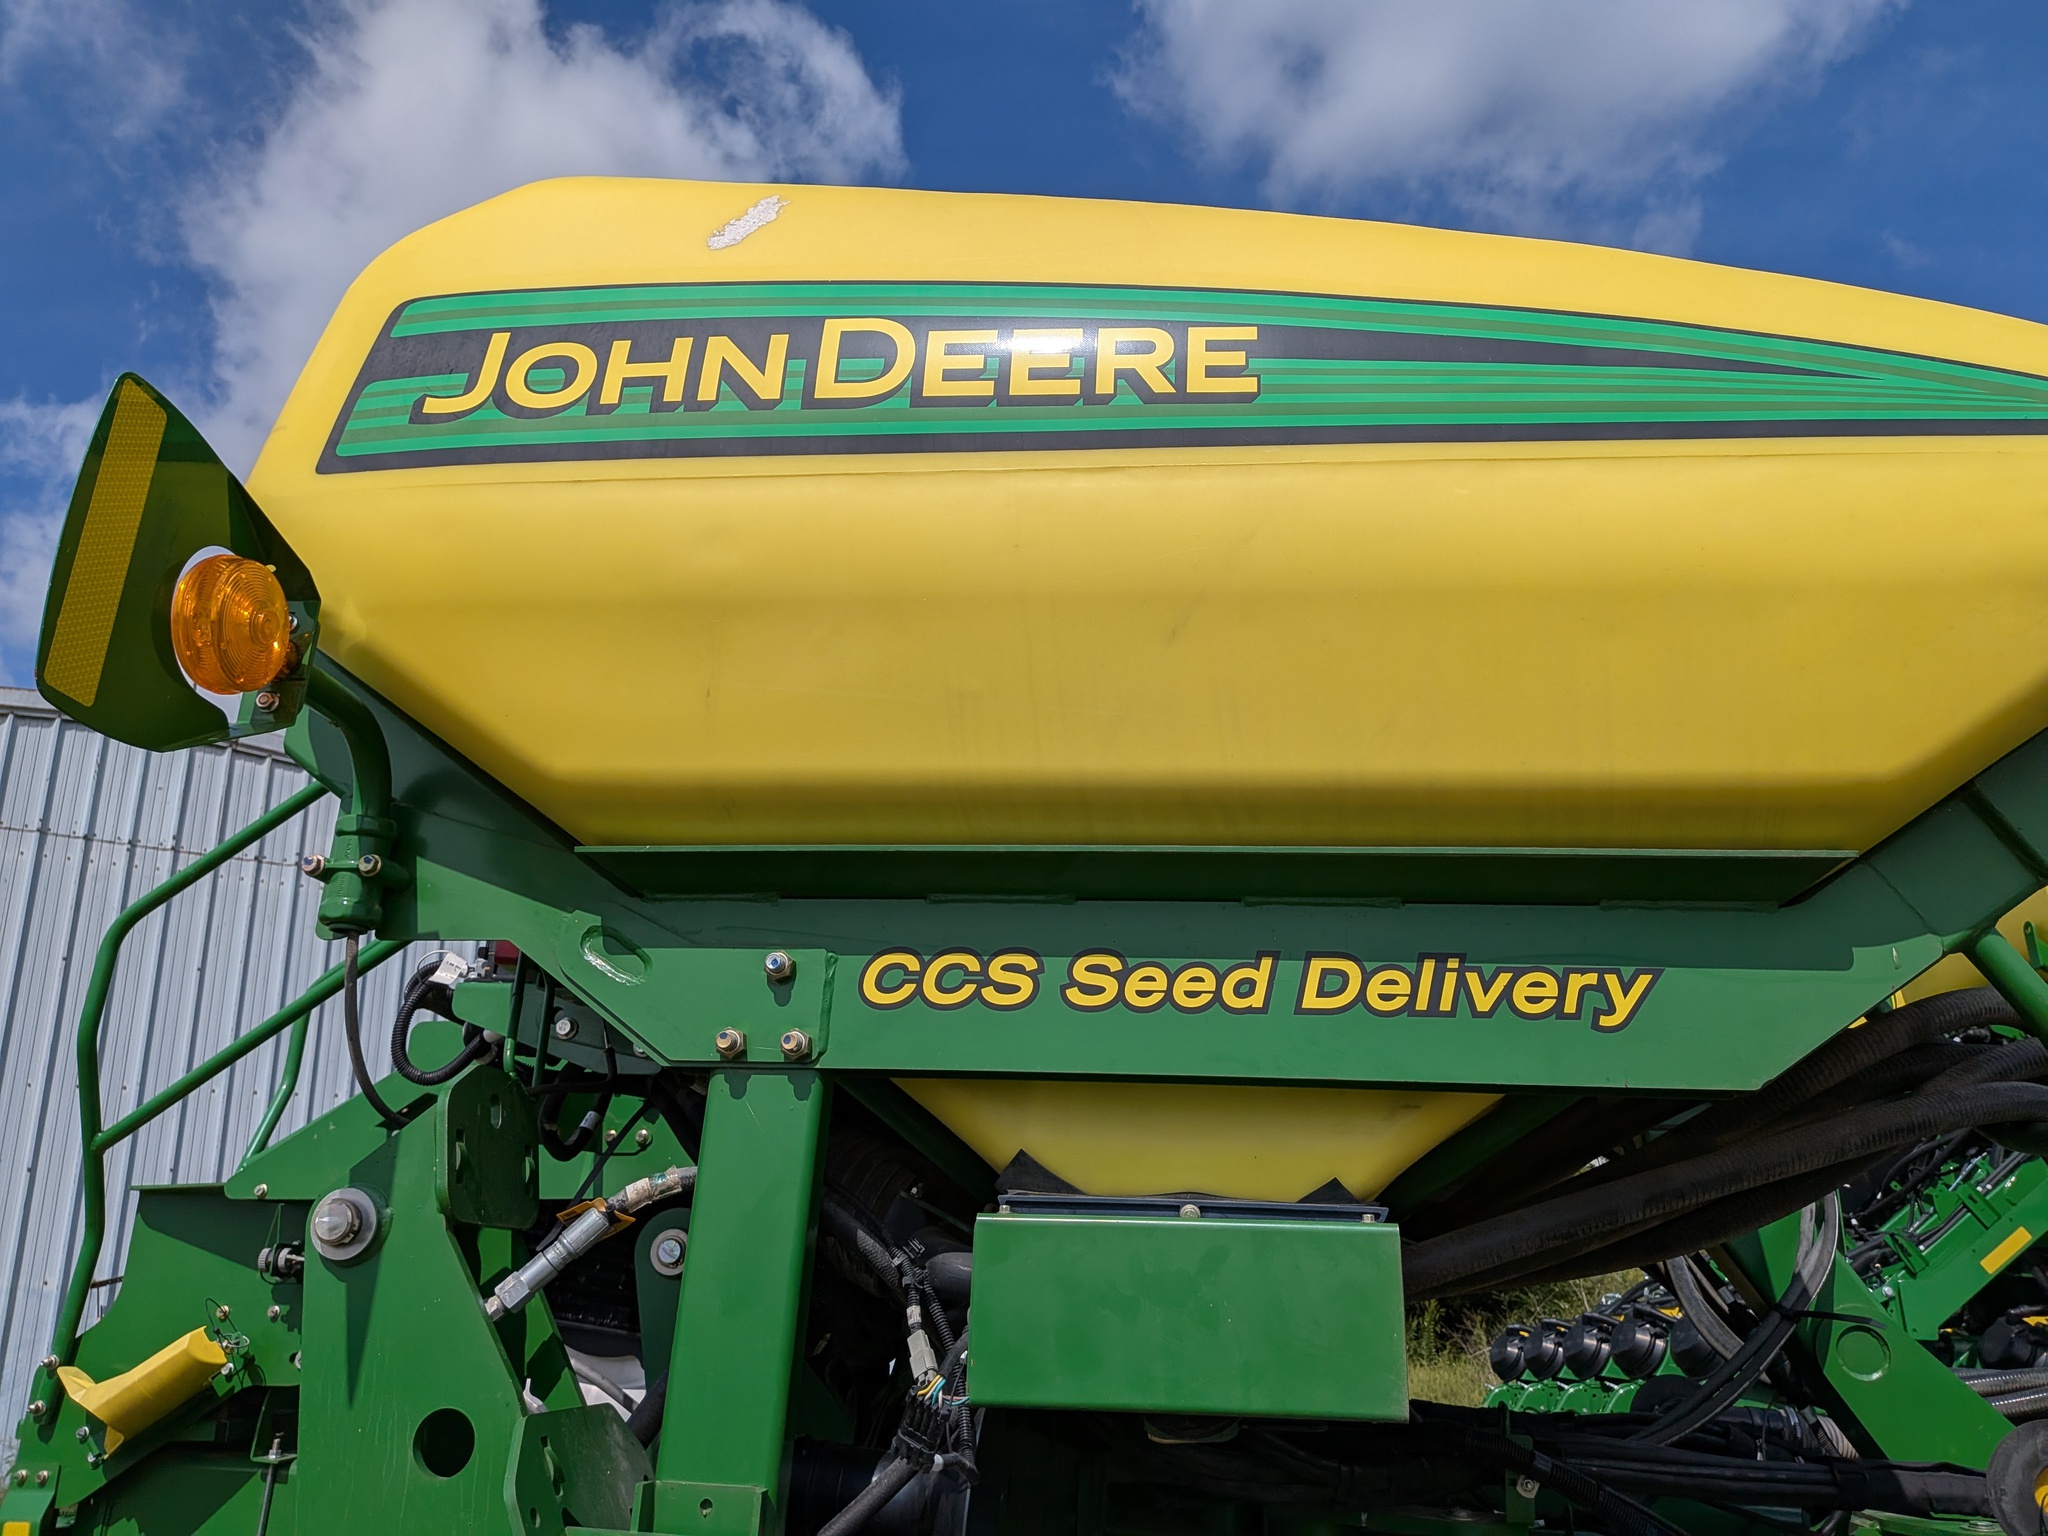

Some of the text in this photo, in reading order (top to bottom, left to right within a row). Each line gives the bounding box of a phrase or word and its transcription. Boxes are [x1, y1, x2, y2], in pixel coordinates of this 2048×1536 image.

[421, 317, 1259, 414] JOHN DEERE
[860, 950, 1655, 1028] CCS Seed Delivery
